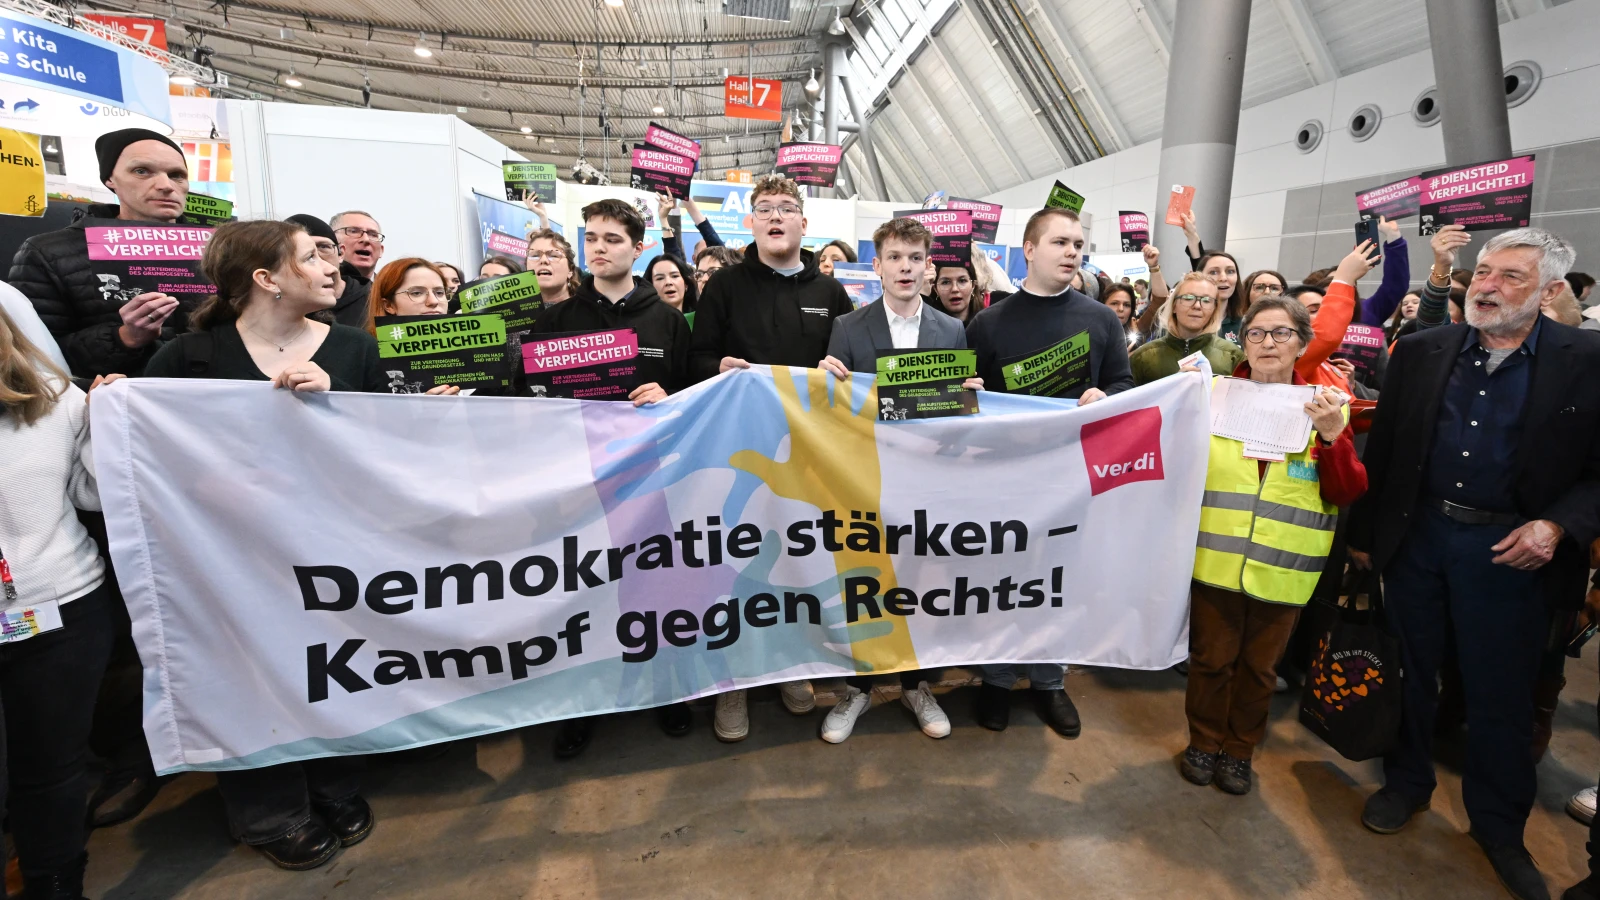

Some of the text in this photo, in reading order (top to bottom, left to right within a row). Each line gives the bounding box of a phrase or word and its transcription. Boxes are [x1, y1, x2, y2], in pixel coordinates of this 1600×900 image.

[12, 27, 57, 53] Kita
[133, 24, 154, 45] 7
[16, 52, 86, 83] Schule
[755, 82, 771, 107] 7
[639, 152, 683, 164] #DIENSTEID
[651, 136, 697, 159] VERPFLICHTET!
[784, 145, 828, 155] #DIENSTEID
[0, 153, 39, 167] HEN-
[638, 159, 690, 175] VERPFLICHTET!
[782, 154, 836, 163] VERPFLICHTET!
[1428, 173, 1526, 200] VERPFLICHTET!
[1429, 163, 1509, 190] #DIENSTEID
[186, 196, 217, 207] NSTEID
[1362, 181, 1409, 201] #DIENSTEID
[1363, 185, 1420, 207] VERPFLICHTET!
[186, 205, 227, 217] LICHTET!
[722, 190, 753, 214] Af
[952, 202, 991, 211] #DIENSTEID
[911, 213, 957, 223] DIENSTEID
[924, 224, 968, 233] FLICHTET!
[103, 229, 212, 243] #DIENSTEID
[725, 239, 745, 248] AfD
[465, 278, 520, 300] #DIENSTEID
[466, 285, 536, 310] VERPFLICHTET!
[390, 319, 480, 340] #DIENSTEID
[1342, 334, 1379, 345] LICHTET!
[1346, 325, 1371, 334] STEID
[391, 332, 500, 354] VERPFLICHTET!
[533, 333, 615, 356] #DIENSTEID
[534, 344, 633, 369] VERPFLICHTET!
[886, 353, 956, 370] #DIENSTEID
[1011, 341, 1073, 375] #DIENSTEID
[1013, 345, 1086, 386] VERPFLICHTET!
[886, 366, 969, 382] VERPFLICHTET!
[1093, 452, 1155, 478] ver.di
[292, 516, 762, 615] Demokratie
[786, 509, 1029, 557] stärken
[306, 566, 1064, 703] Kampf gegen Rechts!
